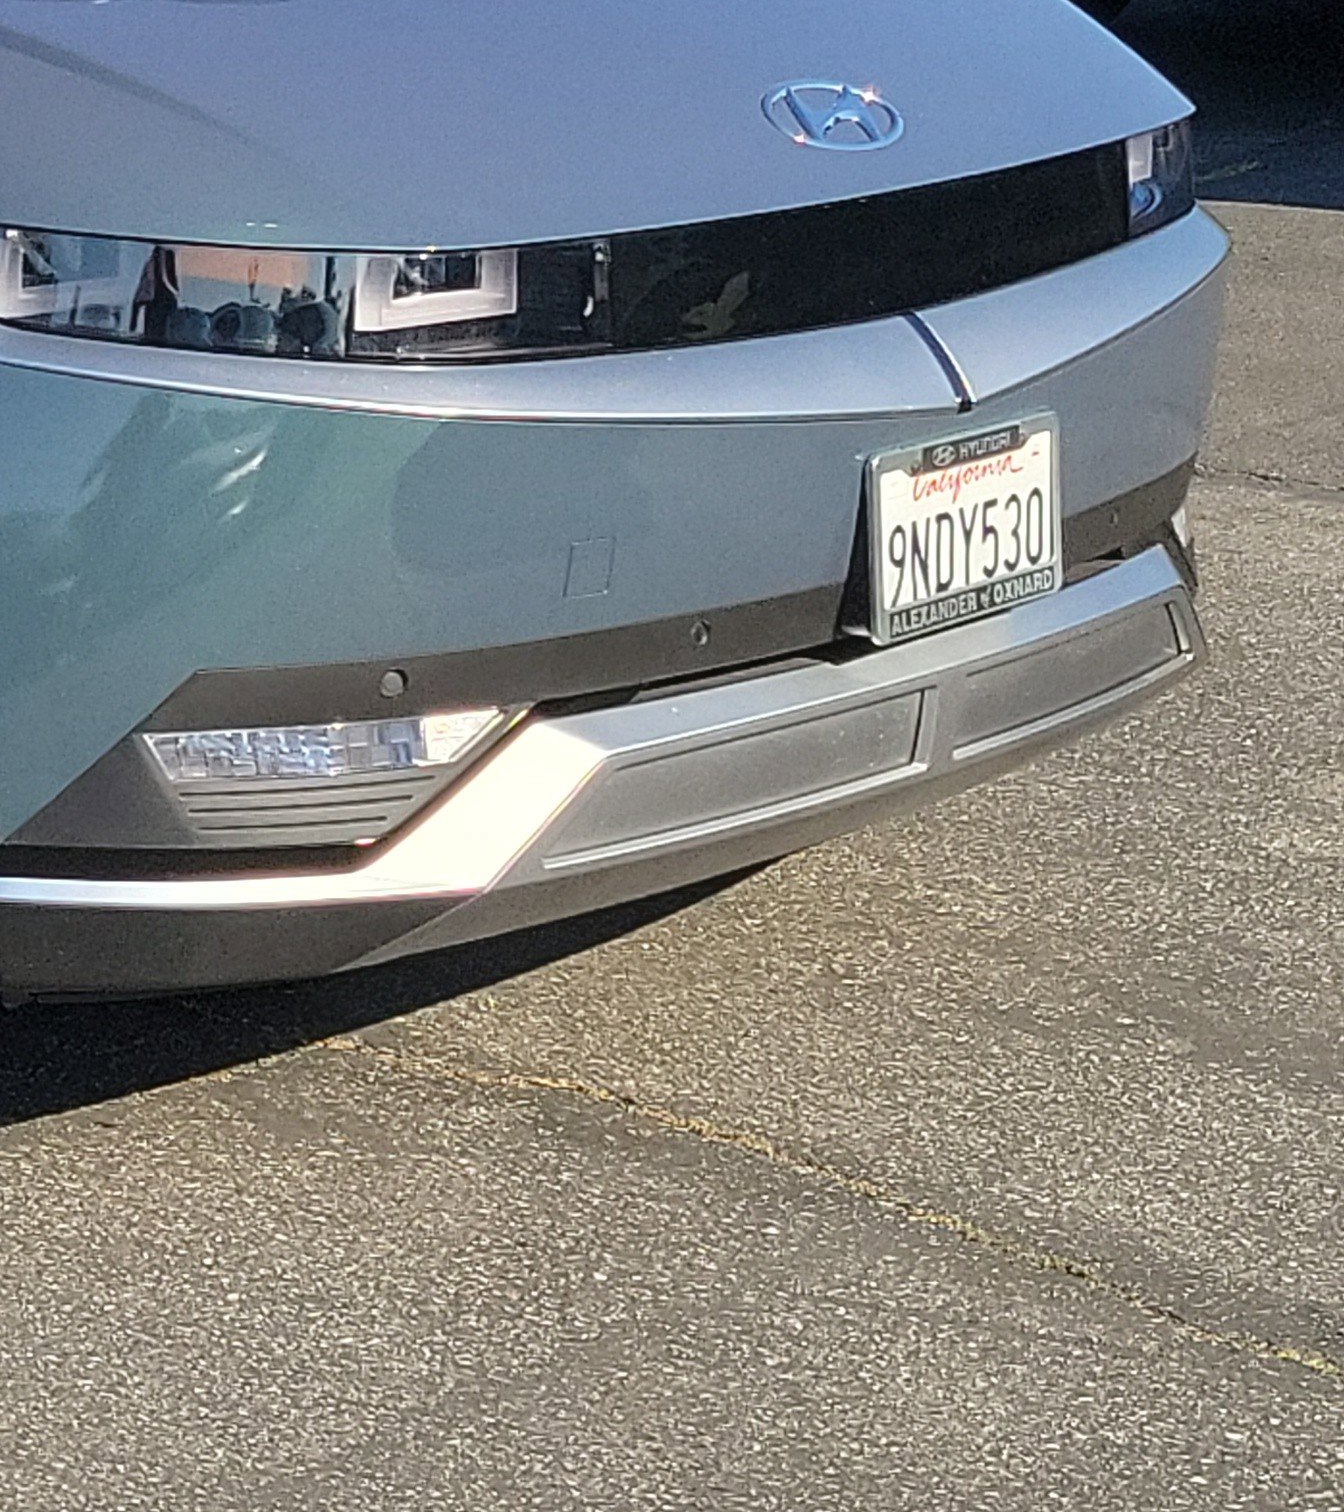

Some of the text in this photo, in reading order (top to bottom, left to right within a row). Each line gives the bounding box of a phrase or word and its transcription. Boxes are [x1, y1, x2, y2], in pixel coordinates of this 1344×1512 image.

[888, 486, 1044, 609] 9NDY530
[891, 591, 978, 637] ALEXANDER
[993, 568, 1054, 605] OXNARD
